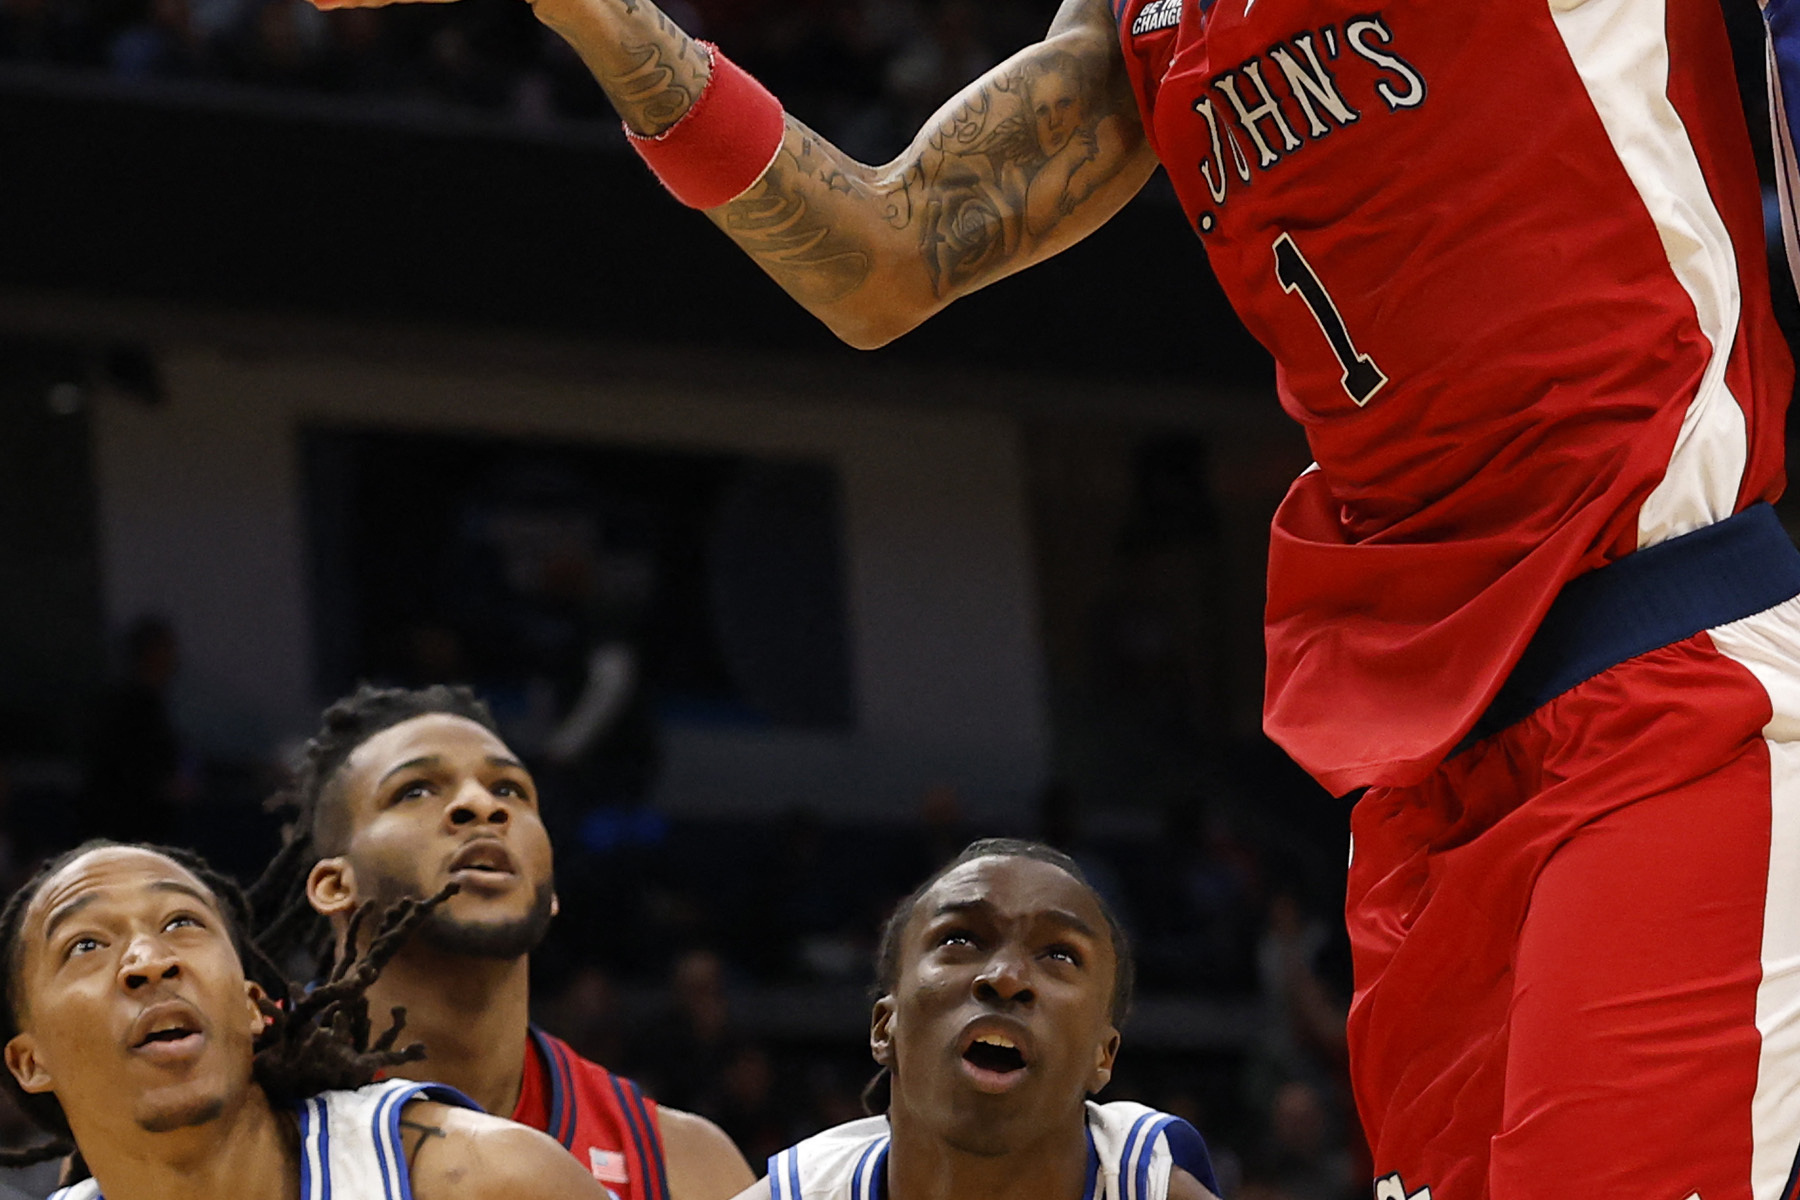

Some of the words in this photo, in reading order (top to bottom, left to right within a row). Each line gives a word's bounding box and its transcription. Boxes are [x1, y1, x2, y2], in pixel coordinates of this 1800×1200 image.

[1140, 0, 1163, 16] BE
[1192, 14, 1427, 205] JHN'S
[1271, 231, 1389, 408] 1
